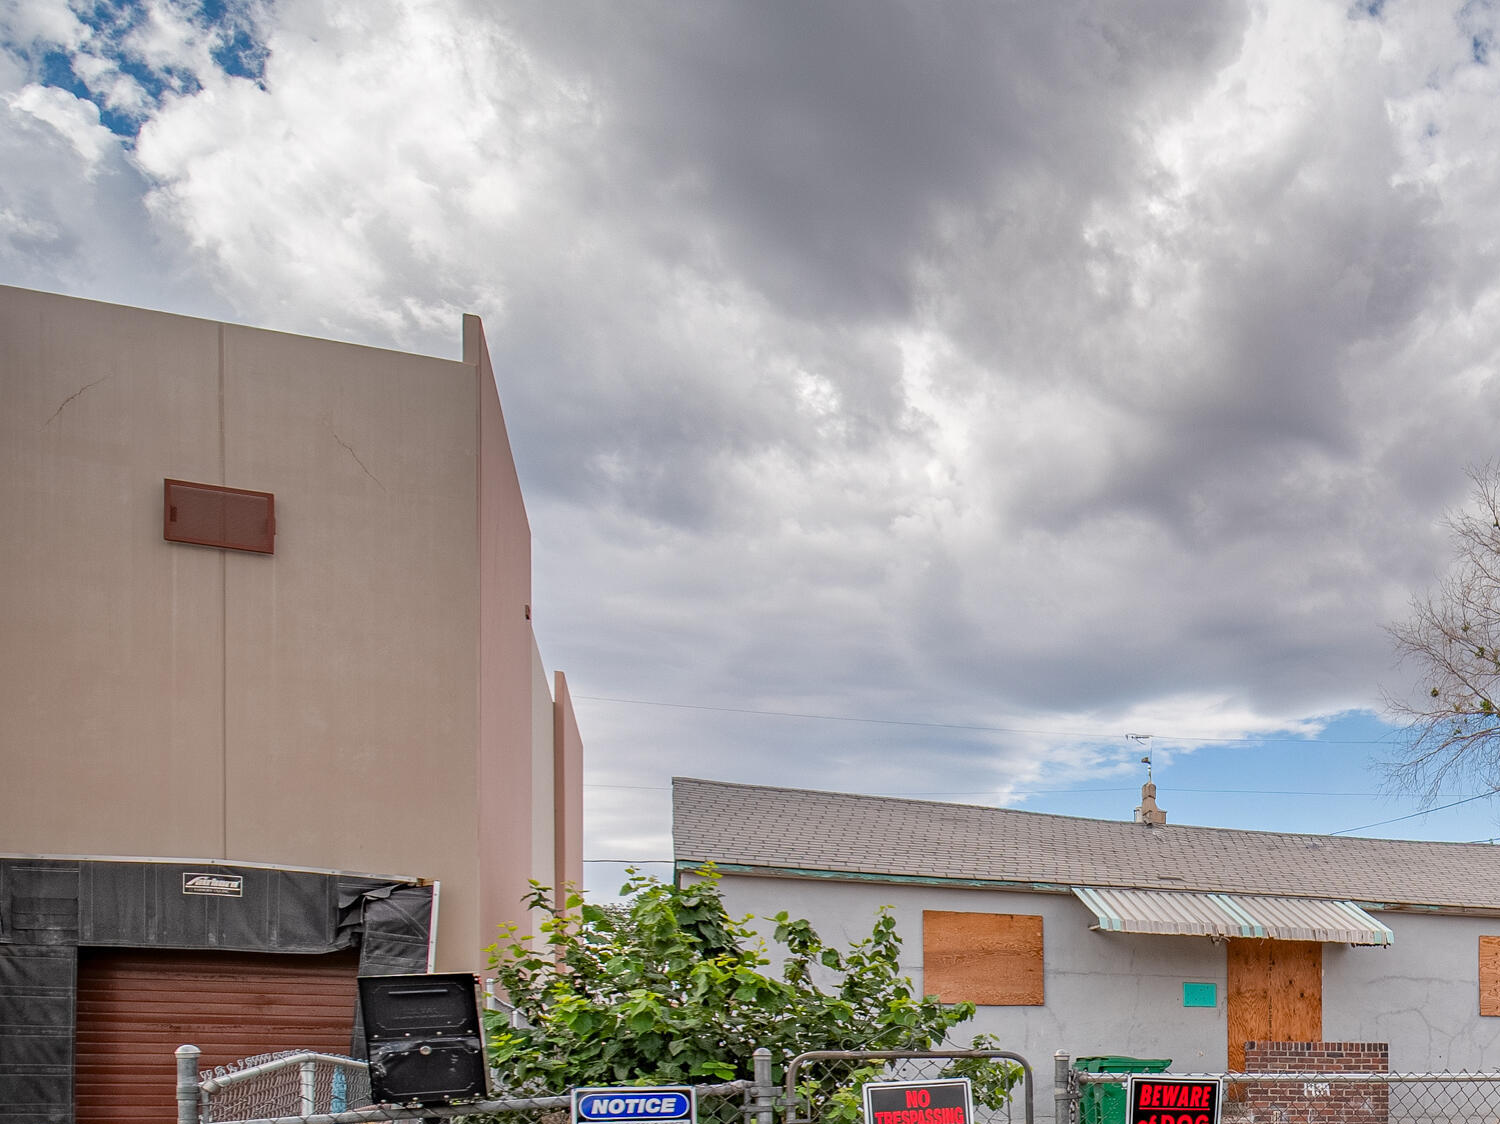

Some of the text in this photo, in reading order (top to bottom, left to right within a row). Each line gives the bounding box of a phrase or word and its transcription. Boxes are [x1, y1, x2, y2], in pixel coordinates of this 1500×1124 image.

[905, 1089, 931, 1108] NO
[1139, 1084, 1212, 1107] BEWARE
[591, 1098, 677, 1114] NOTICE
